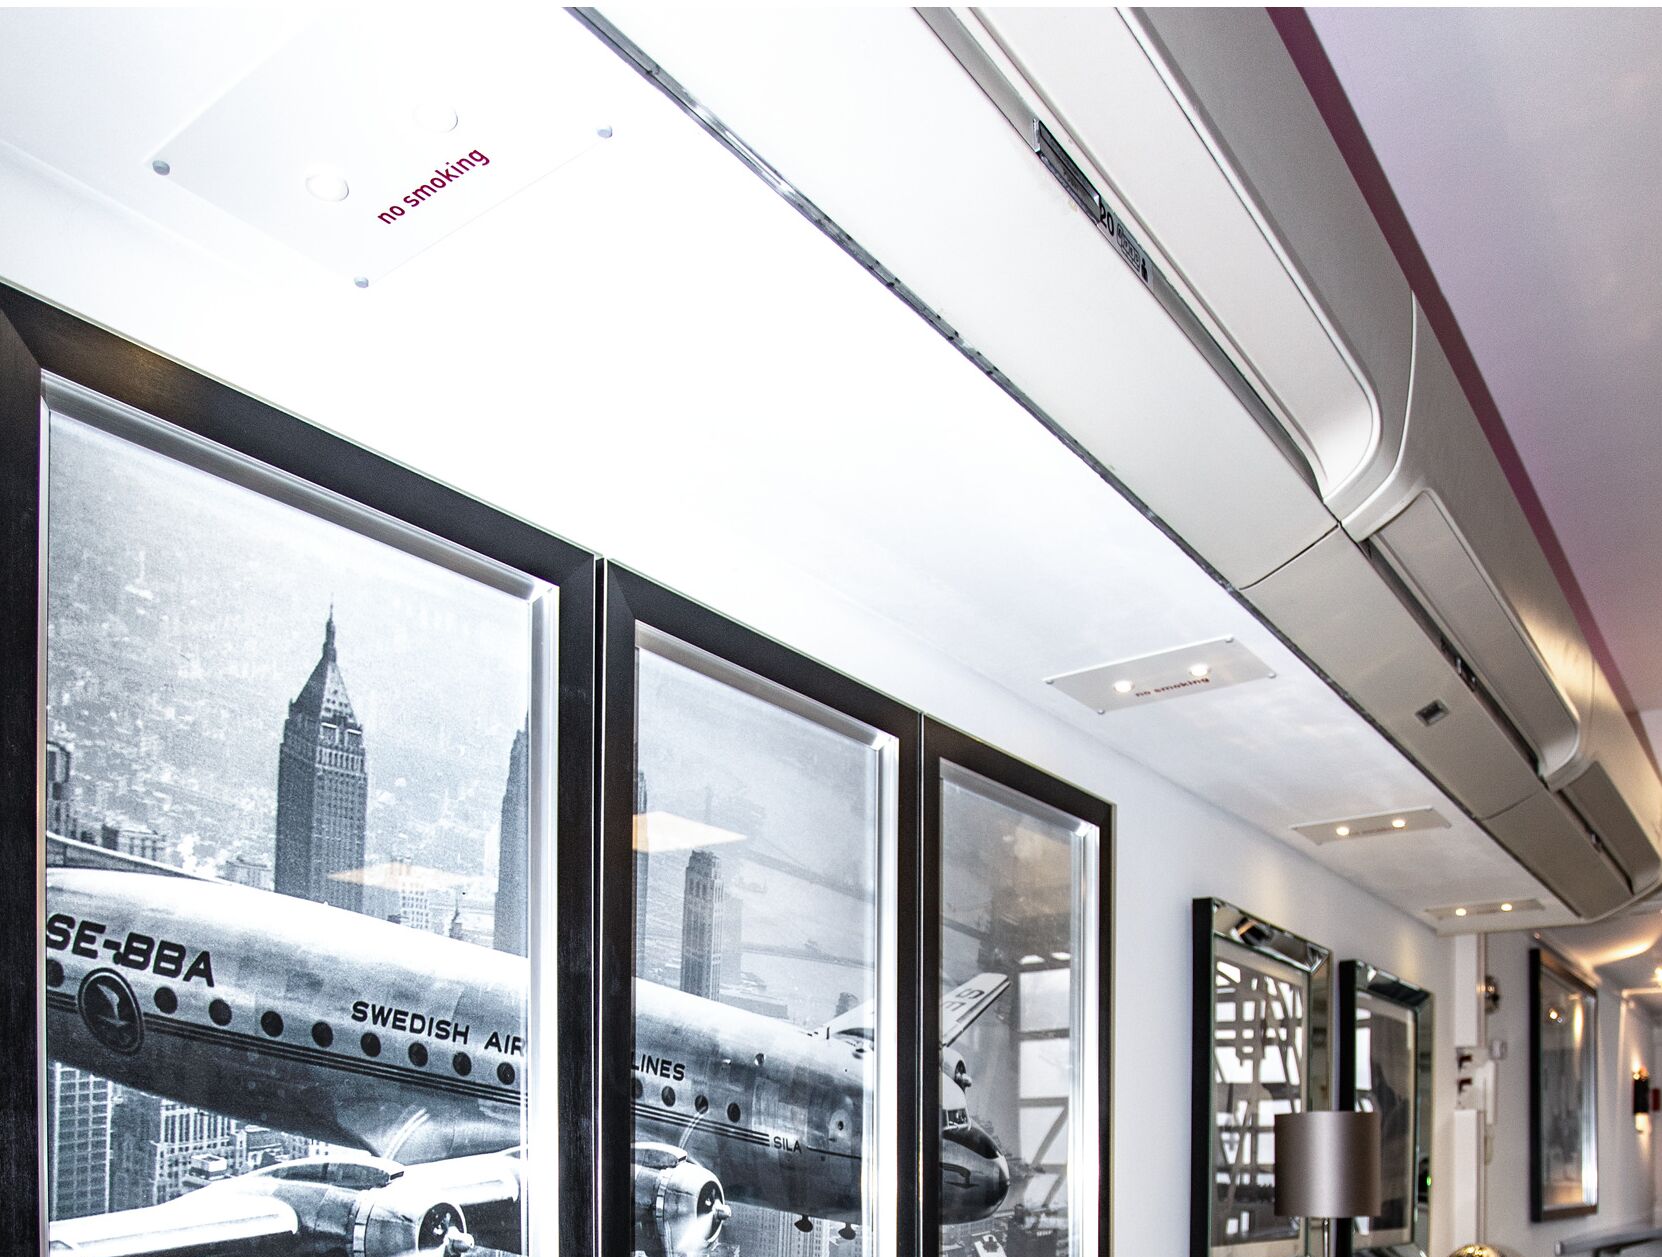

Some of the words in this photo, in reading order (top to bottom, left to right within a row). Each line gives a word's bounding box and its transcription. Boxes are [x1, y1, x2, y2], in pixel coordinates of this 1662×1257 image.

[377, 205, 406, 225] no
[403, 149, 491, 208] smoking
[1154, 677, 1209, 691] smoking
[46, 913, 215, 988] SE-BBA
[351, 1000, 470, 1045] SWEDISH
[484, 1031, 526, 1057] AIR
[631, 1051, 686, 1082] LINES
[773, 1135, 803, 1154] SILA
